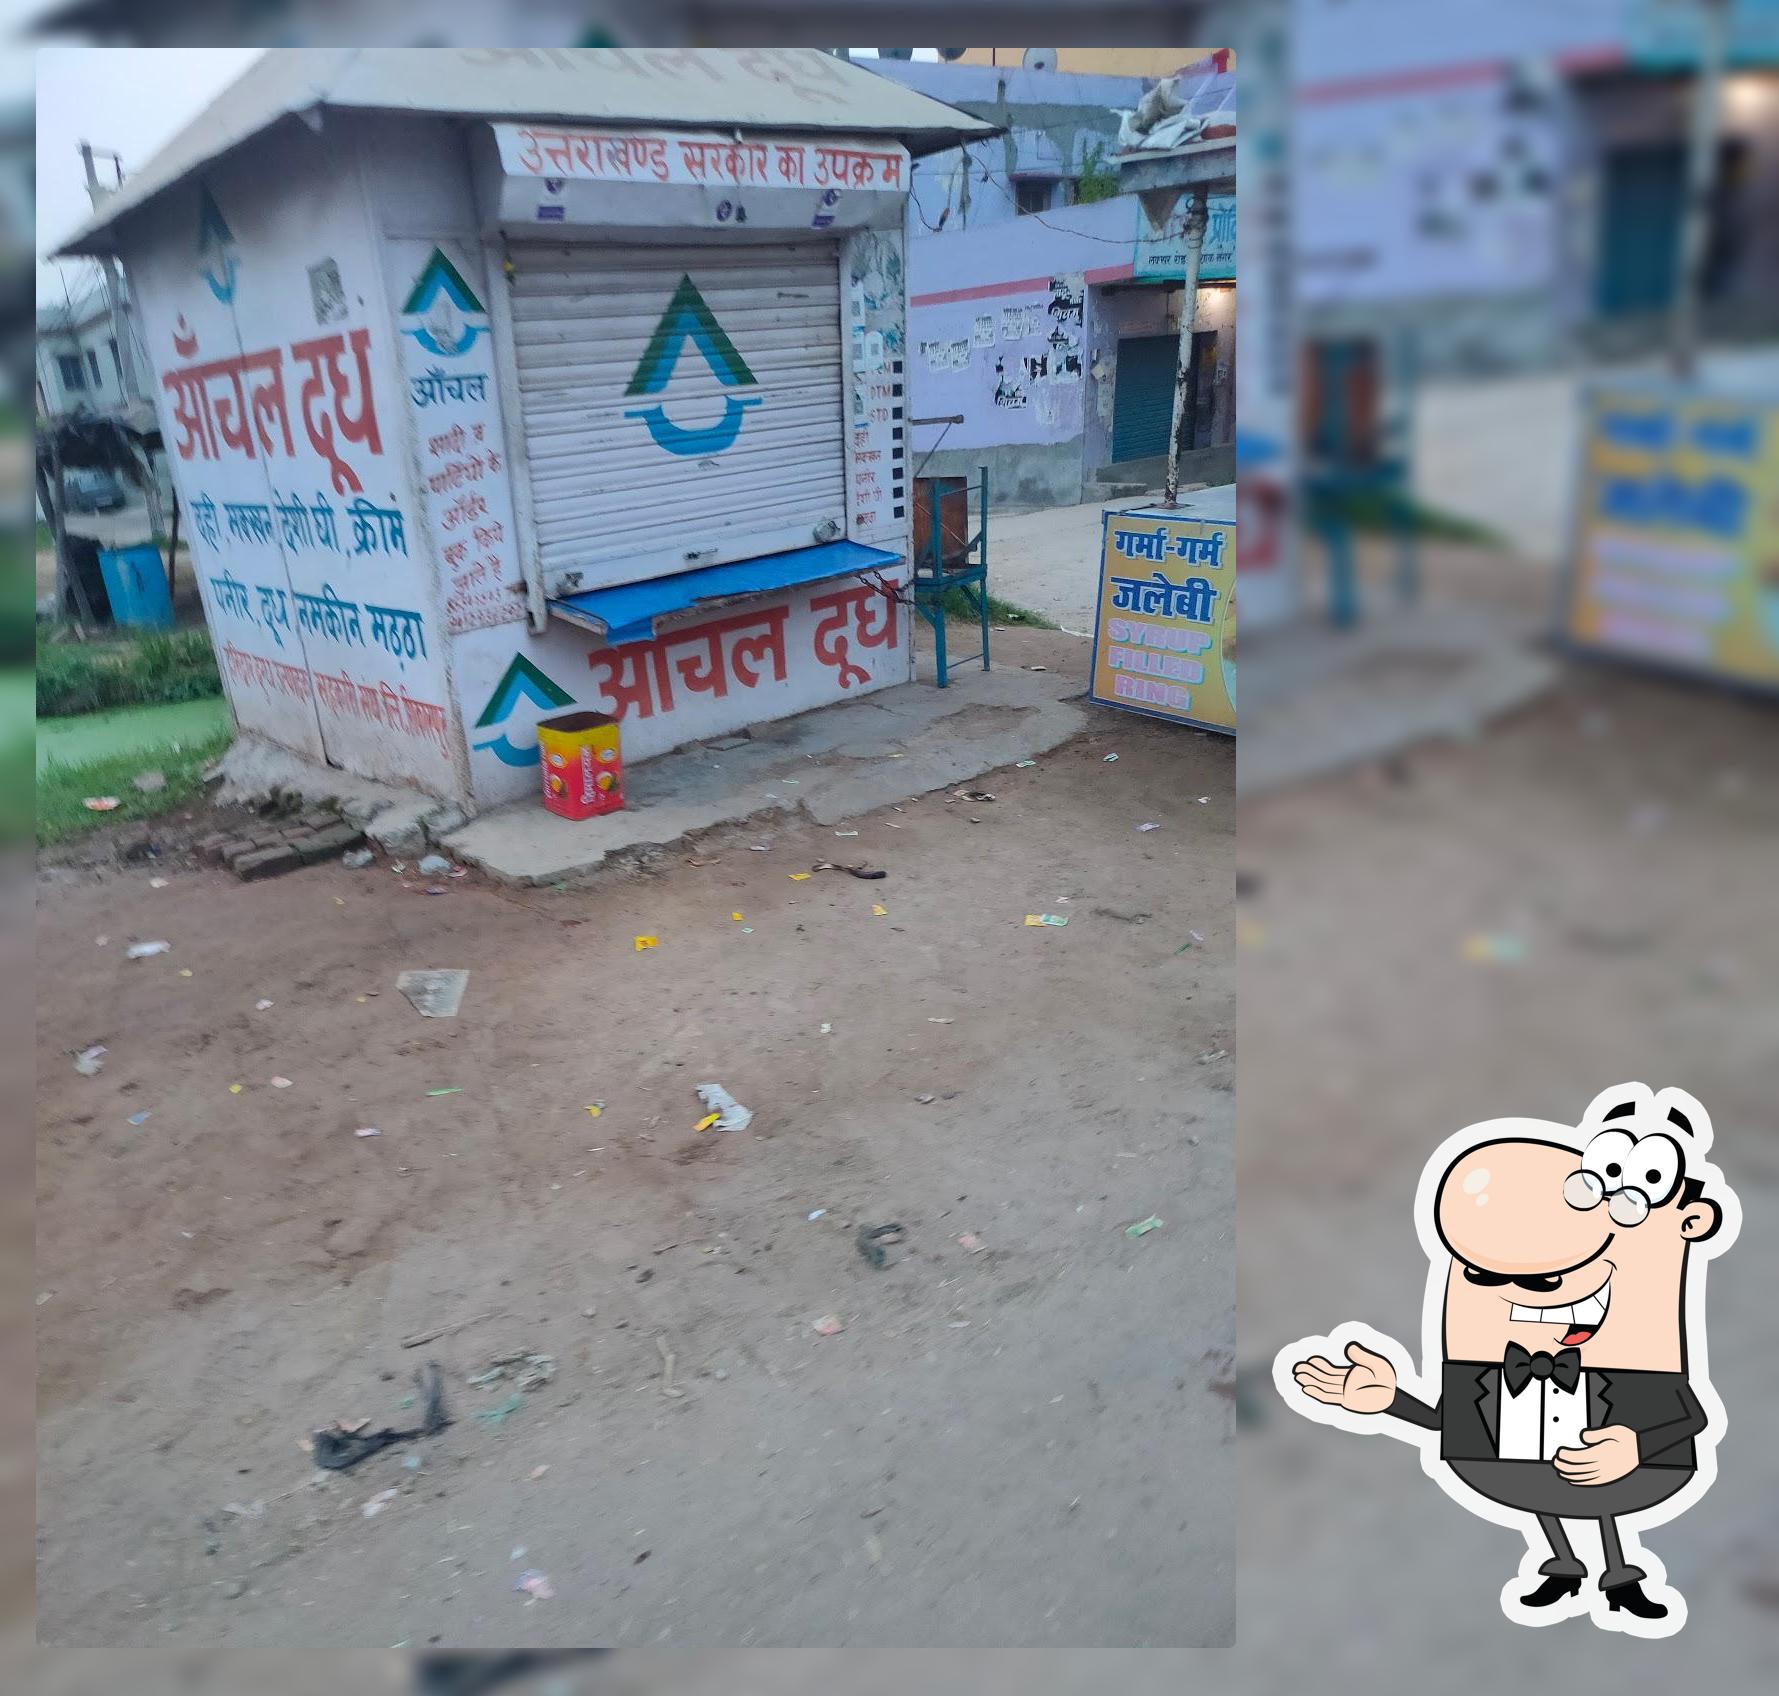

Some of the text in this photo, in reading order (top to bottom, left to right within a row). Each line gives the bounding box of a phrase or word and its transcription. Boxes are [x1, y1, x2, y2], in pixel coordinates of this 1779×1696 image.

[517, 130, 903, 188] उत्तराखण्ड सरकार का उपक्रम
[290, 328, 384, 497] दूध
[1114, 527, 1223, 567] गर्मा-गर्म
[1110, 572, 1217, 622] जलेबी
[809, 578, 900, 689] दूध
[1108, 618, 1213, 656] SYRUP
[1108, 645, 1205, 684] FILLED
[1114, 674, 1191, 711] RING
